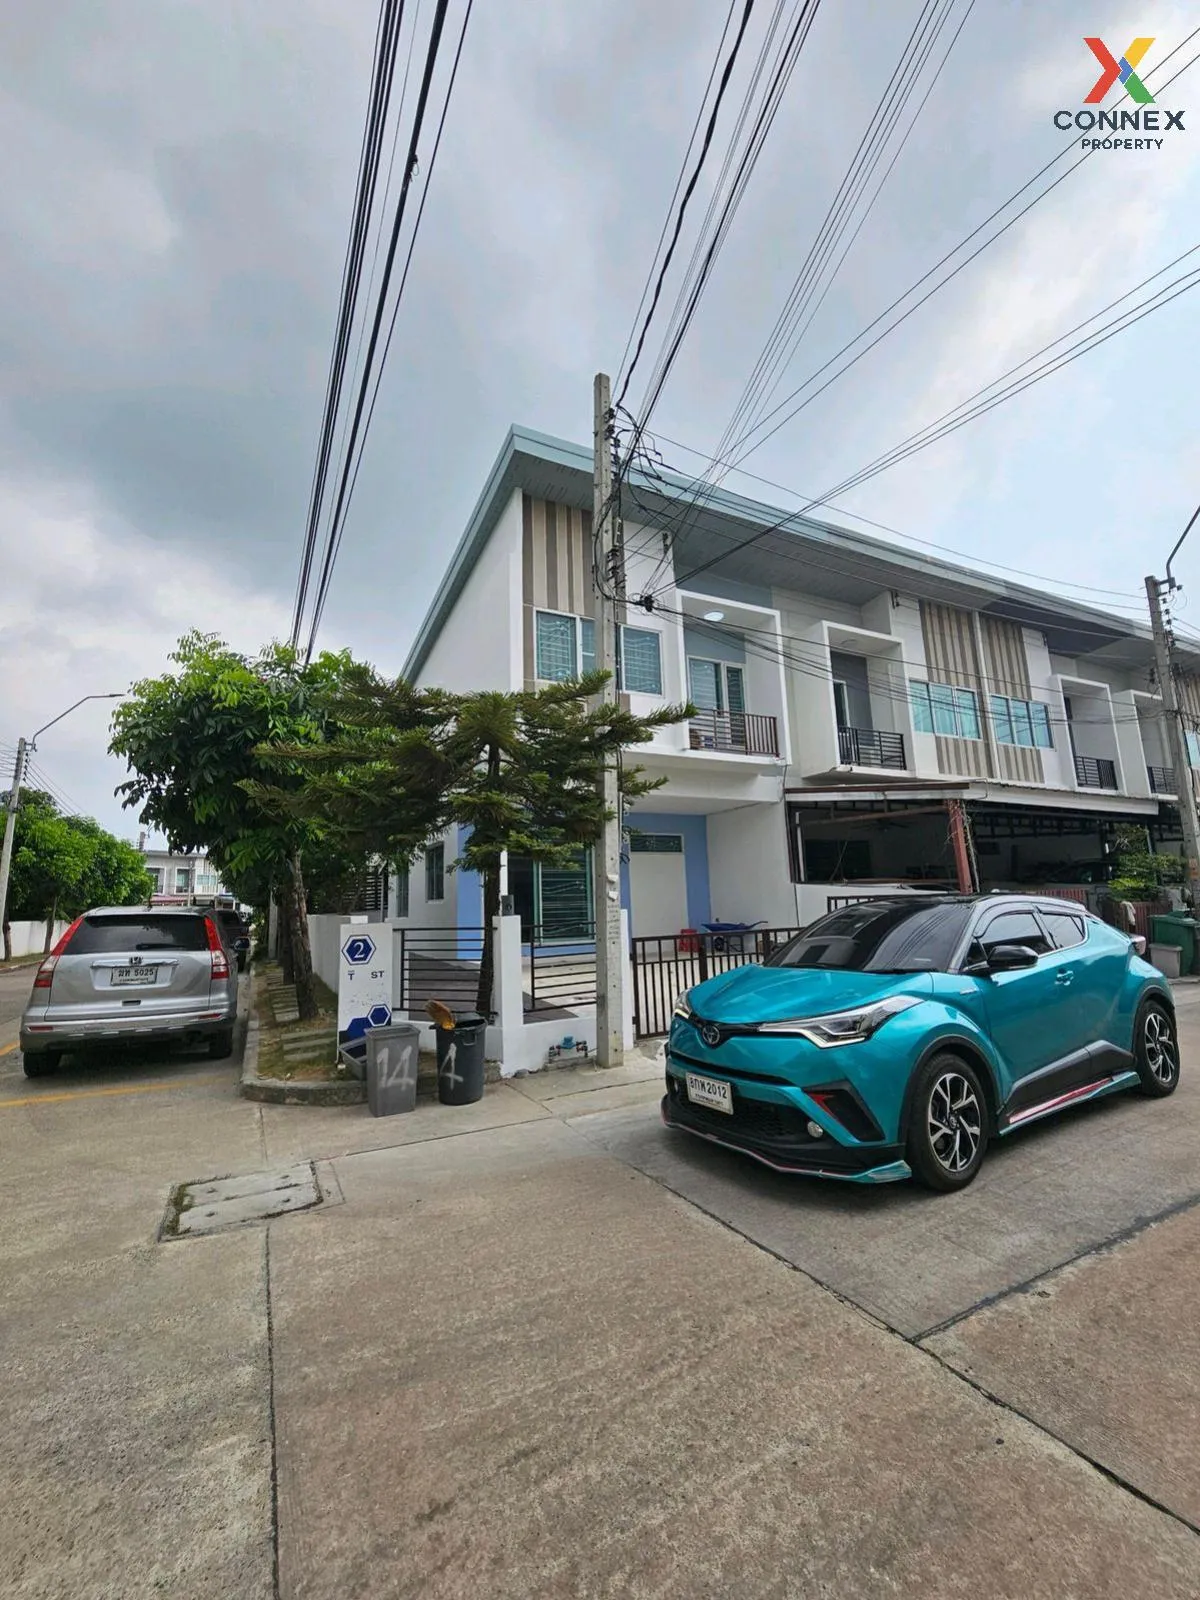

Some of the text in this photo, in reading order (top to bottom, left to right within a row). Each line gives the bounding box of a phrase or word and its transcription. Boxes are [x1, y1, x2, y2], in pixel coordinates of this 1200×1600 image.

[353, 941, 365, 959] 2
[371, 970, 385, 979] ST
[377, 1046, 415, 1091] 14
